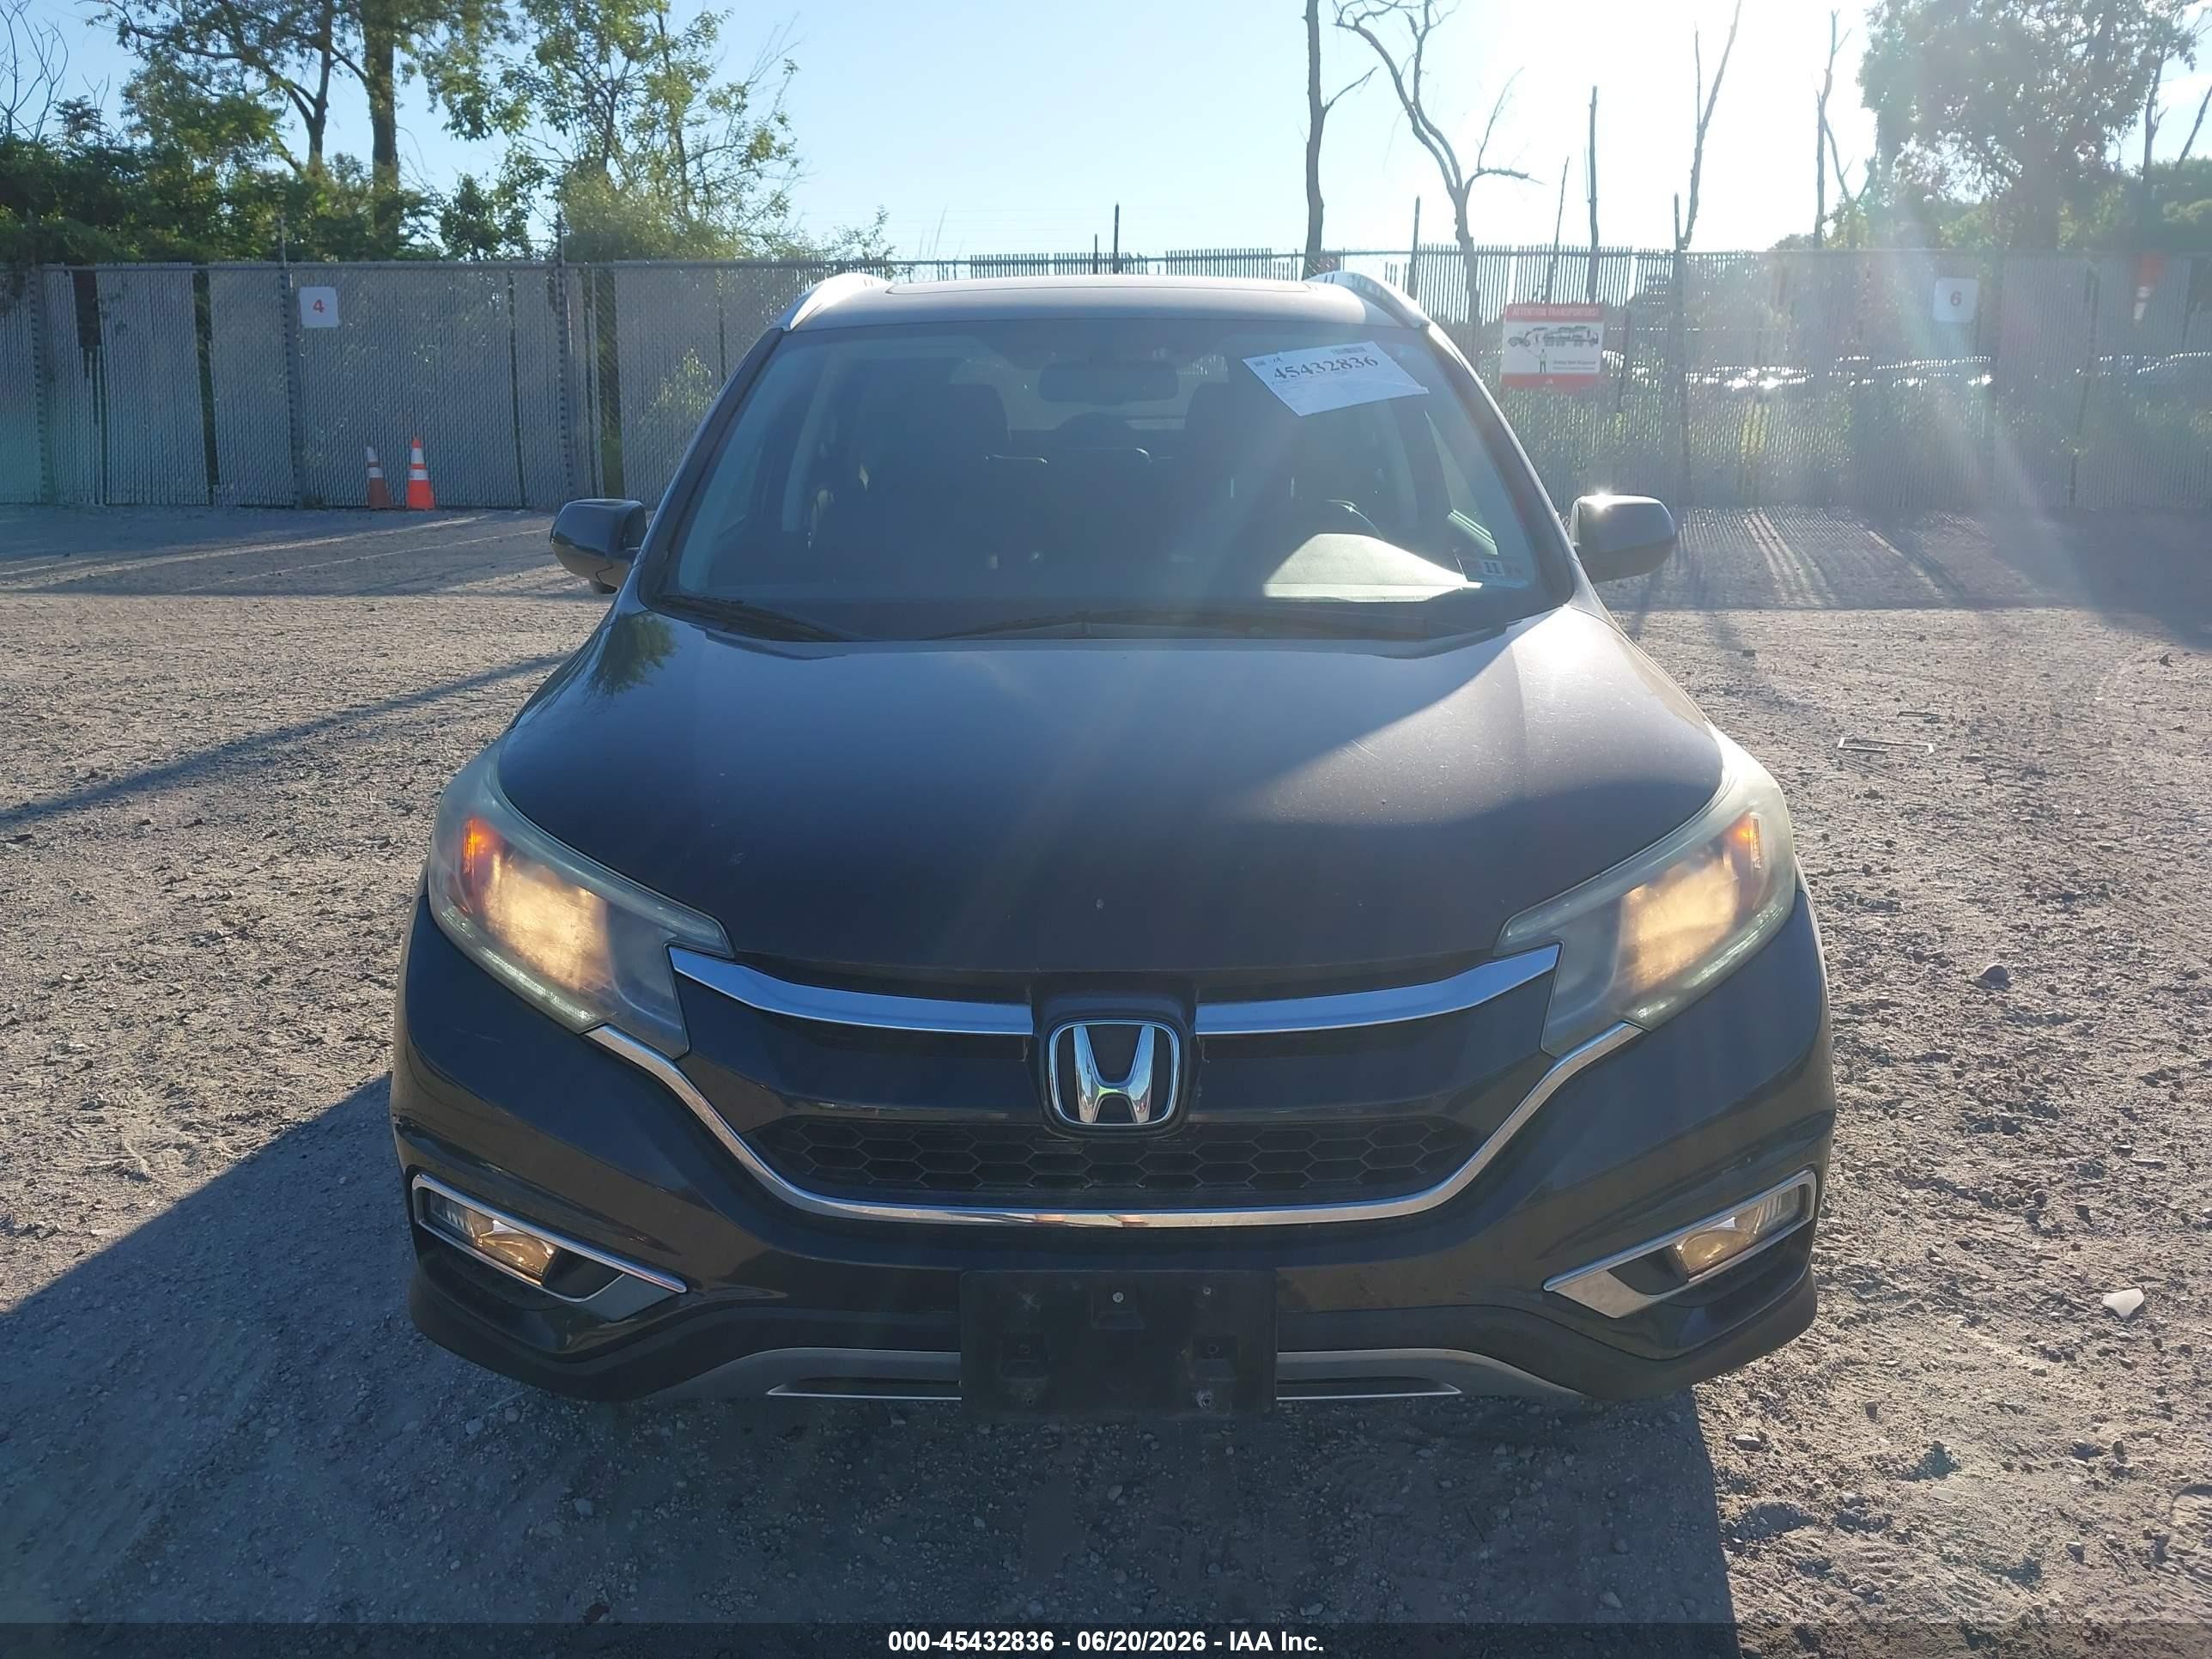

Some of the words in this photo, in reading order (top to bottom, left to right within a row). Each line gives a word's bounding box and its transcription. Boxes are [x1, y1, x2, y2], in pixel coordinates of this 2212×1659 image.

[313, 298, 325, 313] 4
[1950, 290, 1962, 307] 6
[1274, 356, 1379, 380] 45432836
